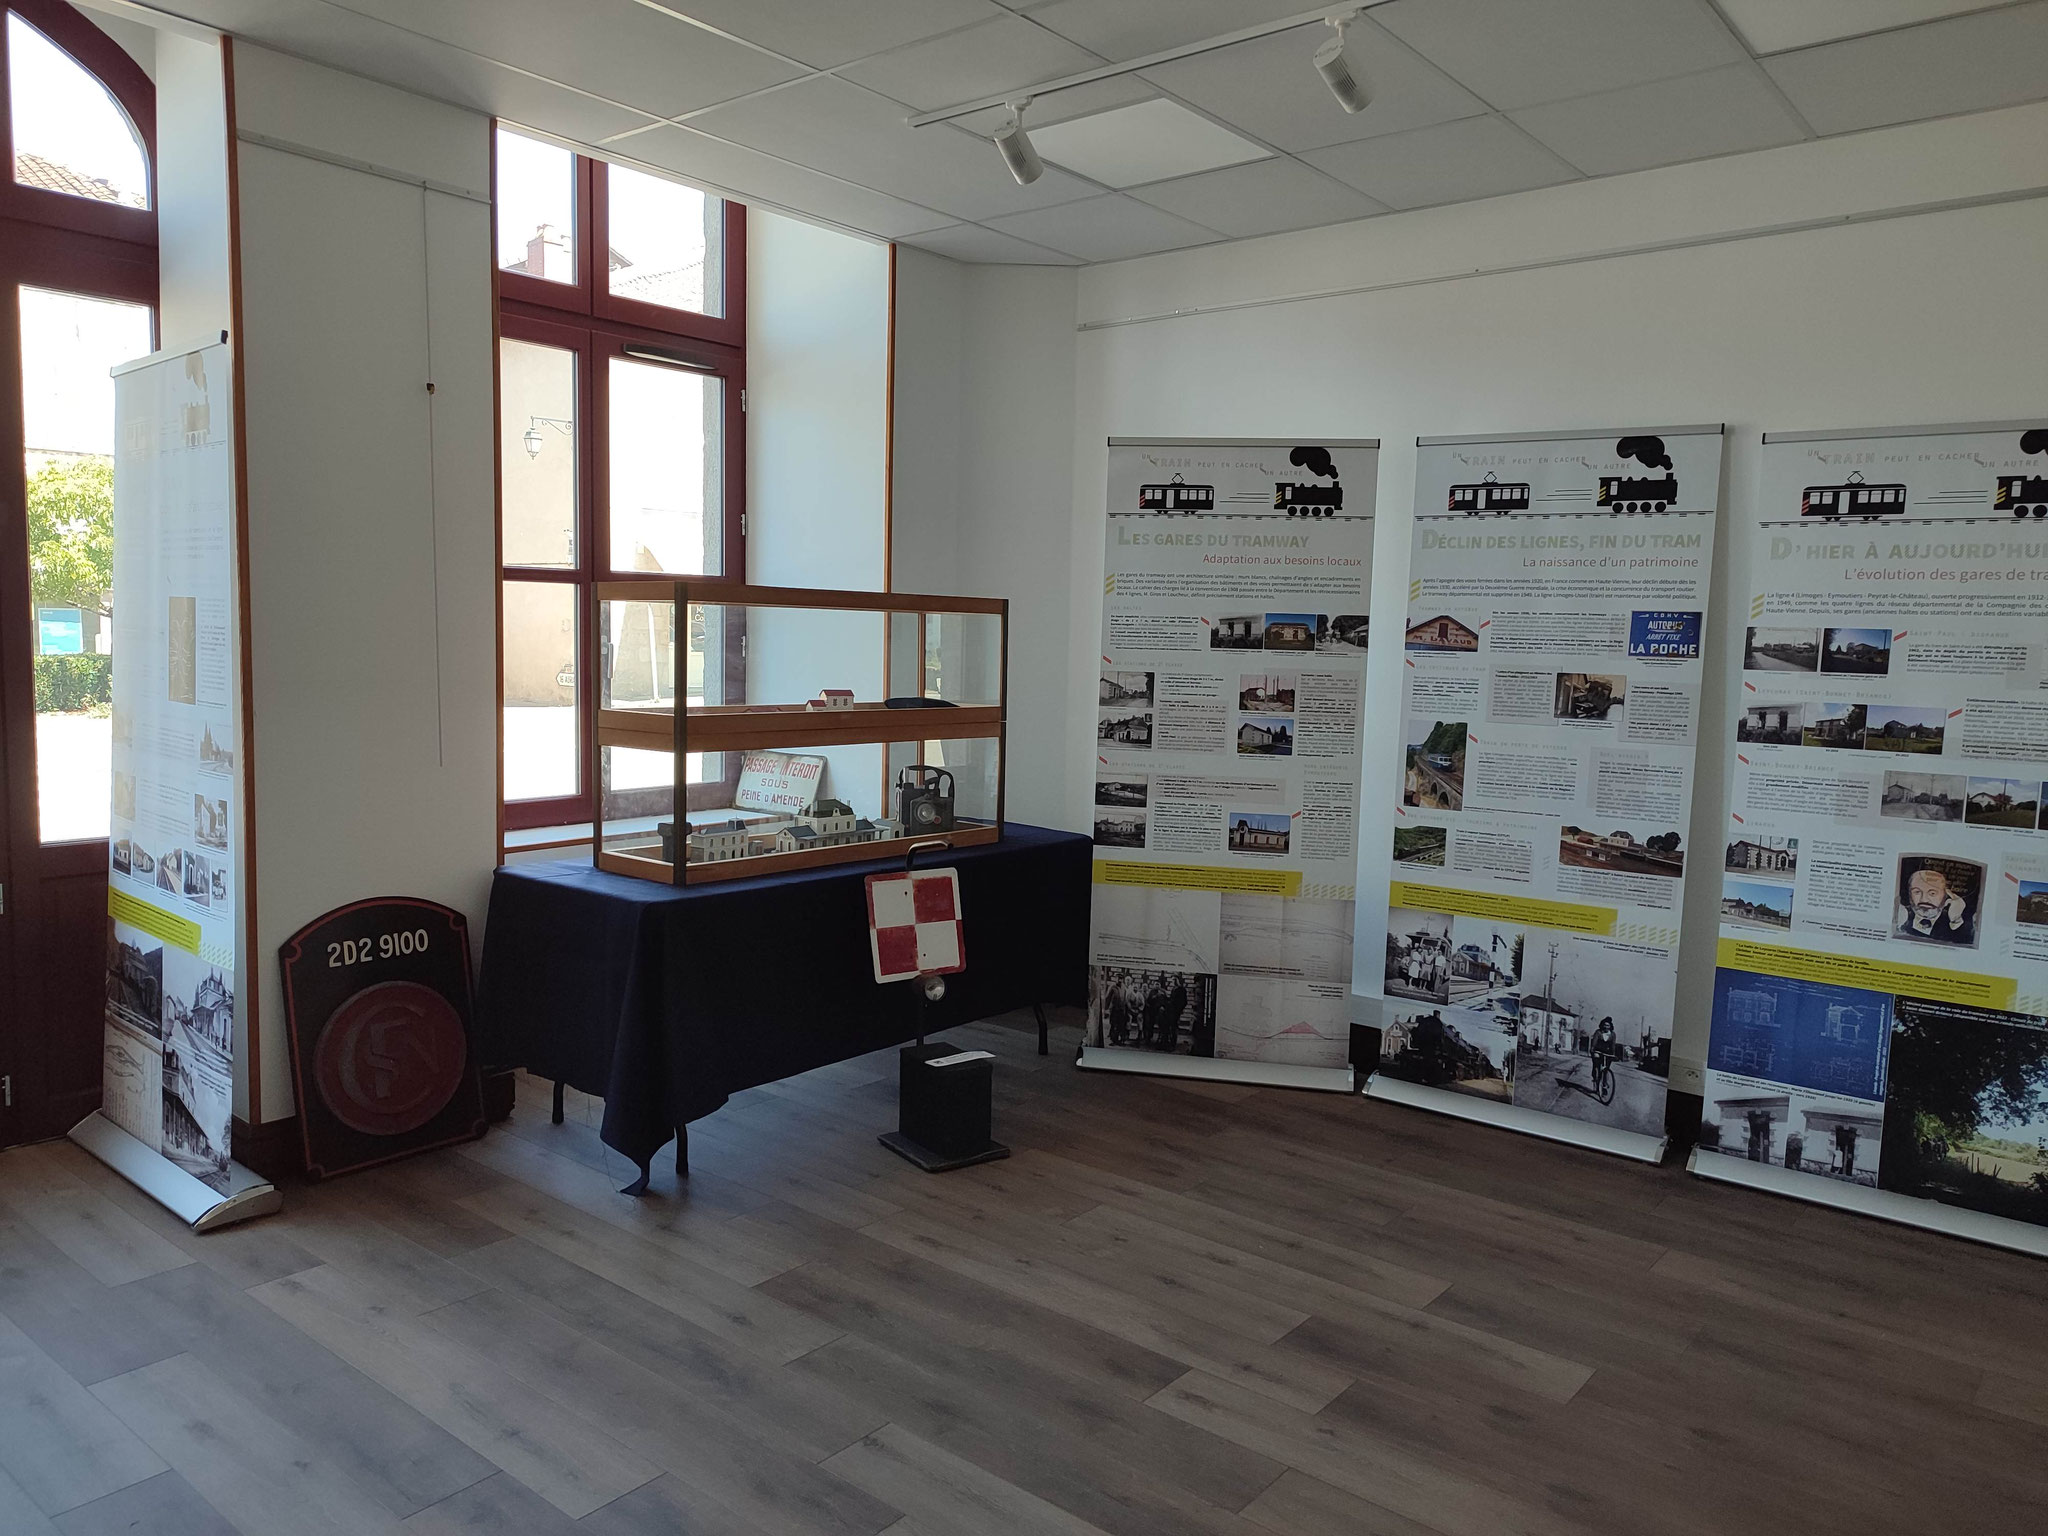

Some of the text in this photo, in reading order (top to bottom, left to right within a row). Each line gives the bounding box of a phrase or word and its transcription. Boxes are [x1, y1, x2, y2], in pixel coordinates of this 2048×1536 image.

[1152, 458, 1192, 467] TRAIN
[1464, 455, 1505, 466] TRAIN
[1823, 453, 1876, 464] TRAIN
[1938, 453, 1980, 461] CACHER
[1118, 526, 1310, 548] LES GARES DU TRAMWAY
[1421, 529, 1701, 551] DÉCLIN DES LIGNES, FIN DU TRAM
[1865, 542, 1879, 559] À
[1203, 554, 1261, 566] Adaptation
[1285, 555, 1324, 566] besoins
[1327, 556, 1362, 566] locaux
[1523, 556, 1698, 571] La naissance d'un patrimoine
[1844, 568, 1926, 581] L'évolution
[1930, 568, 1956, 580] des
[1960, 571, 2002, 583] gares
[2006, 568, 2026, 580] de
[1986, 600, 2027, 609] Compagnie
[1648, 621, 1683, 630] AUTOBUS
[1431, 635, 1472, 645] LAVAUD
[1630, 643, 1697, 654] LA ROCHE
[744, 755, 819, 780] PASSAGE INTERDIT
[761, 778, 789, 789] SOUS
[741, 789, 761, 801] PEINE
[327, 928, 429, 968] 2D2 9100
